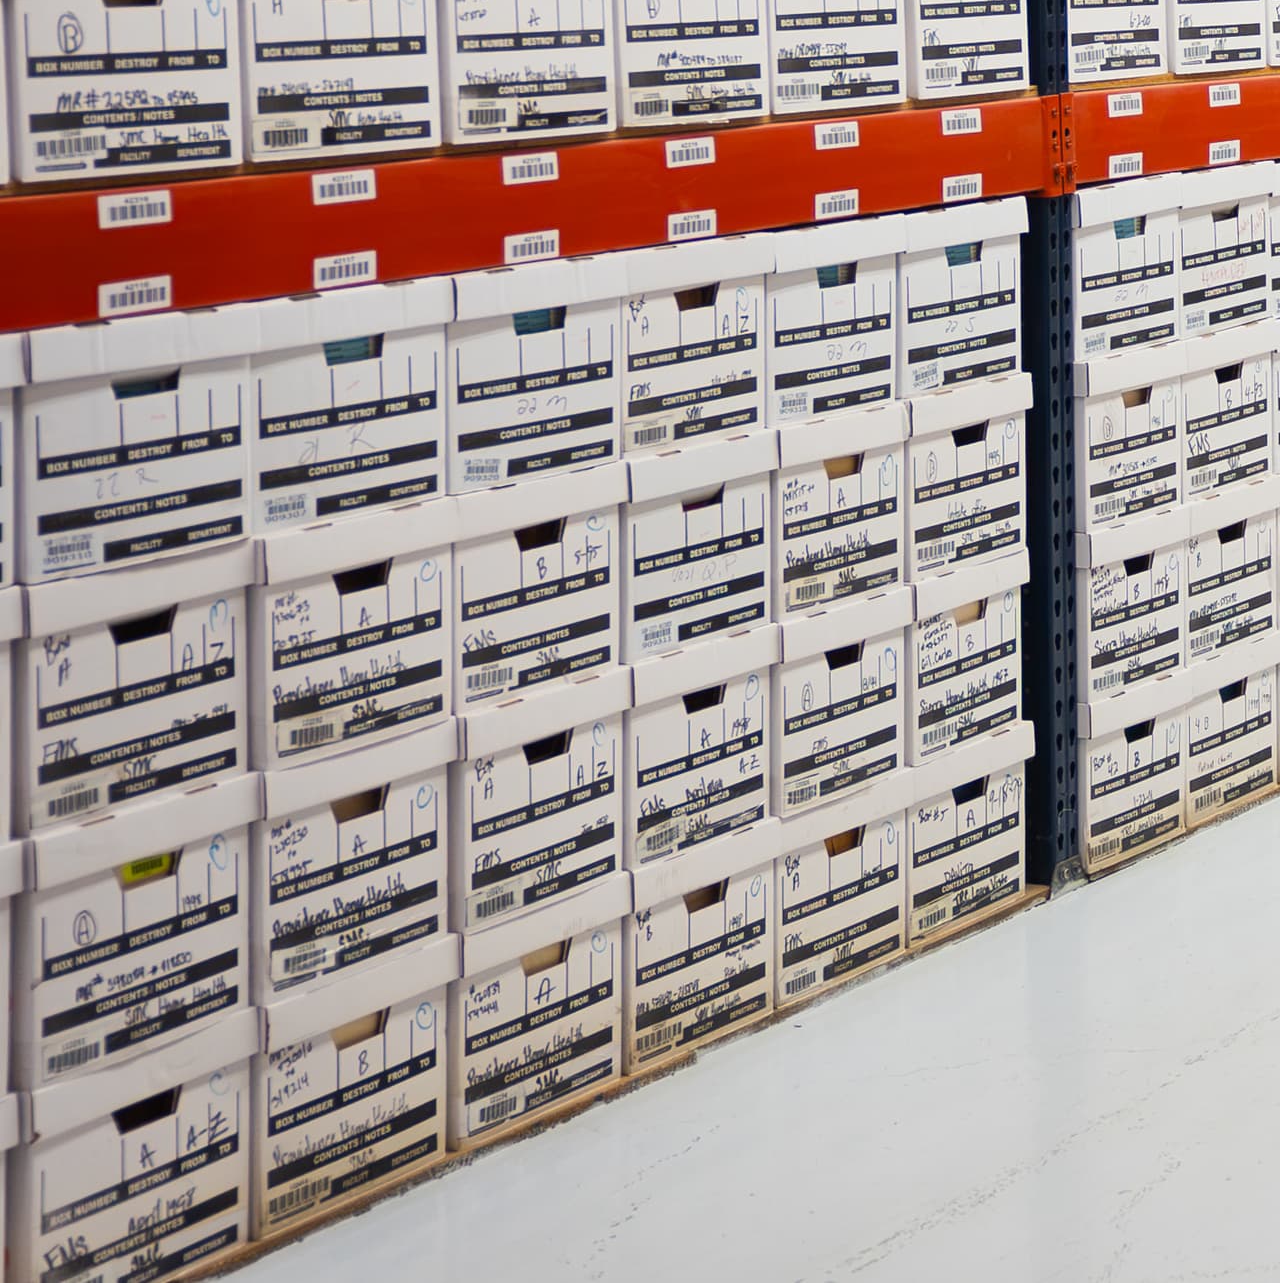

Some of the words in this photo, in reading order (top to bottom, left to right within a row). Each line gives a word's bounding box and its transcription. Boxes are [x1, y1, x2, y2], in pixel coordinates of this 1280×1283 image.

[36, 63, 58, 73] BOX
[61, 60, 103, 71] NUMBER
[115, 58, 159, 69] DESTROY
[168, 56, 195, 66] FROM
[208, 55, 219, 64] TO
[83, 113, 136, 124] CONTENTS
[144, 110, 175, 120] NOTES
[47, 462, 69, 473] BOX
[72, 454, 116, 470] NUMBER
[128, 444, 172, 460] DESTROY
[182, 439, 208, 451] FROM
[221, 433, 233, 443] TO
[95, 502, 148, 520] CONTENTS
[155, 494, 187, 508] NOTES
[131, 539, 163, 552] FACILITY
[188, 524, 232, 541] DEPARTMENT
[640, 562, 653, 571] BOX
[656, 554, 683, 566] NUMBER
[690, 544, 719, 558] DESTROY
[725, 538, 742, 549] FROM
[751, 534, 759, 542] TO
[669, 591, 703, 607] CONTENTS
[708, 585, 728, 597] NOTES
[359, 606, 372, 627] A
[280, 654, 298, 664] BOX
[301, 643, 337, 659] NUMBER
[347, 630, 384, 647] DESTROY
[392, 622, 414, 635] FROM
[425, 617, 435, 627] TO
[46, 711, 67, 722] BOX
[70, 697, 112, 714] NUMBER
[124, 682, 167, 702] DESTROY
[176, 673, 202, 687] FROM
[215, 666, 228, 676] TO
[320, 686, 363, 704] CONTENTS
[370, 677, 396, 691] NOTES
[90, 743, 142, 764] CONTENTS
[150, 731, 182, 747] NOTES
[125, 778, 158, 793] FACILITY
[182, 757, 226, 776] DEPARTMENT
[967, 809, 976, 827] A
[353, 835, 367, 855] A
[277, 884, 295, 898] BOX
[298, 872, 334, 889] NUMBER
[343, 856, 380, 876] DESTROY
[388, 846, 410, 860] FROM
[421, 838, 430, 848] TO
[315, 914, 359, 935] CONTENTS
[366, 902, 392, 918] NOTES
[51, 959, 73, 973] BOX
[76, 944, 119, 964] NUMBER
[129, 925, 173, 947] DESTROY
[182, 913, 208, 928] FROM
[219, 904, 231, 914] TO
[534, 977, 557, 1005] A
[275, 1115, 294, 1129] BOX
[297, 1100, 334, 1119] NUMBER
[343, 1080, 379, 1102] DESTROY
[387, 1068, 409, 1082] FROM
[420, 1058, 430, 1068] TO
[140, 1143, 157, 1168] A
